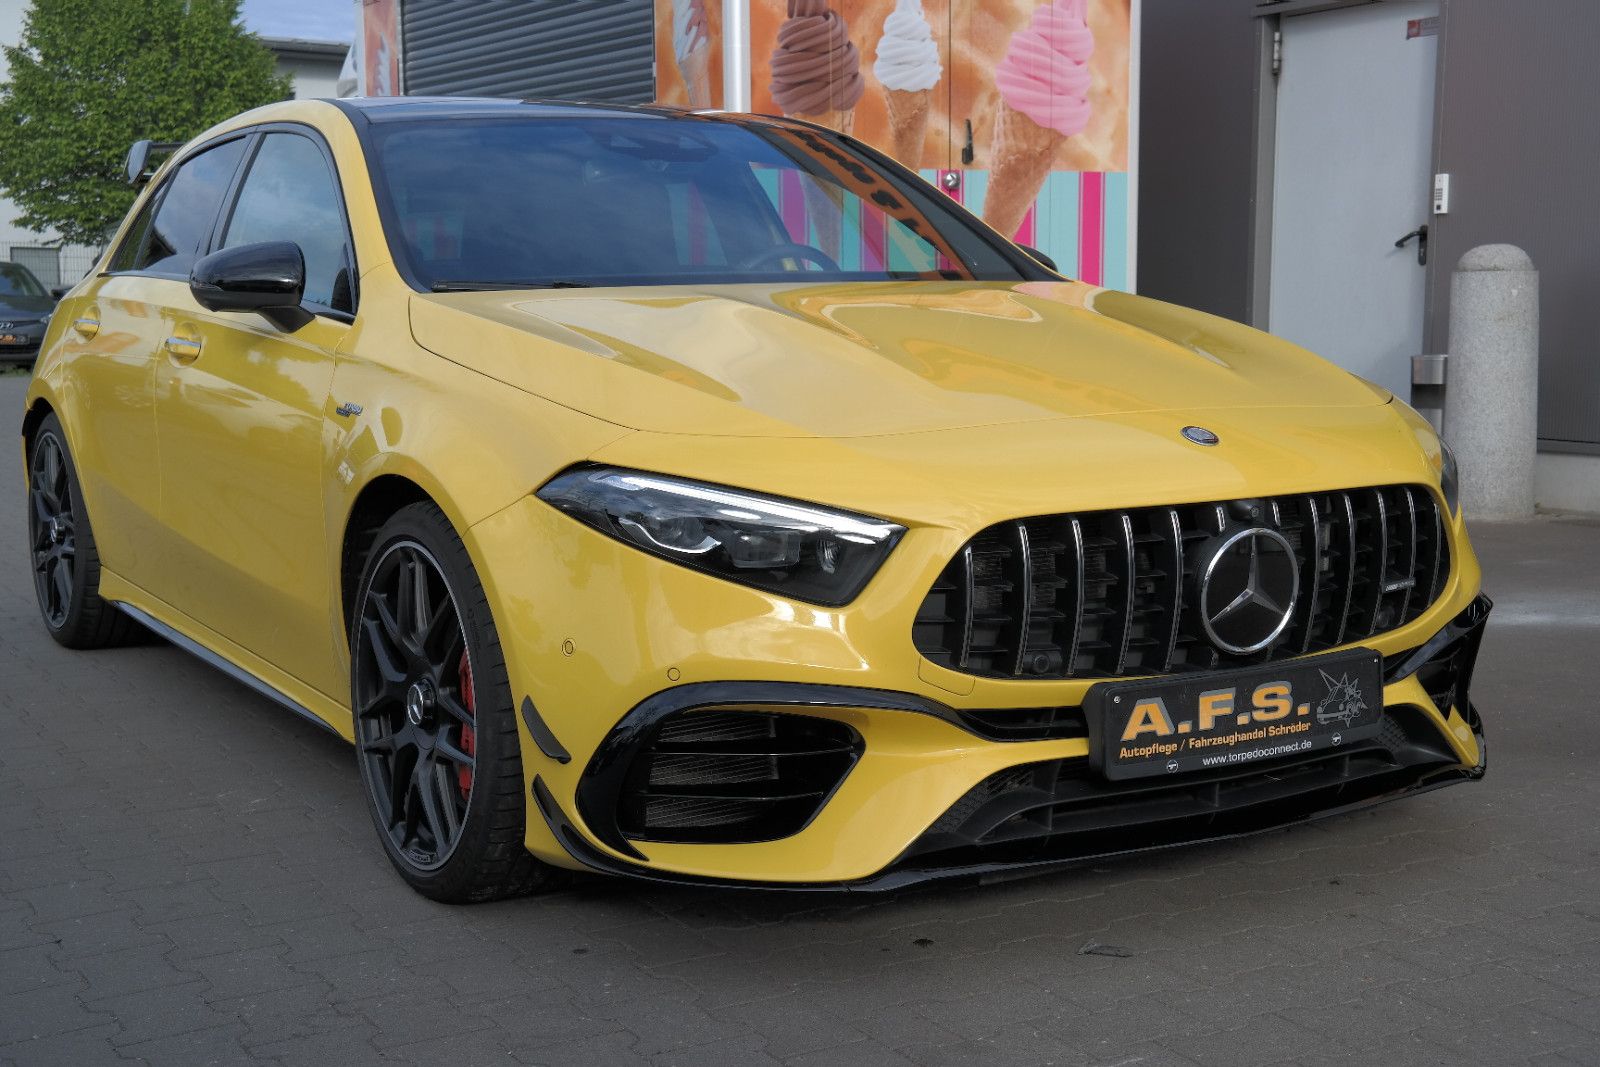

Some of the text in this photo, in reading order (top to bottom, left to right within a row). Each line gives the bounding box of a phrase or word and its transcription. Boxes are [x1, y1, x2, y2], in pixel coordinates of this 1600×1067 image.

[1120, 681, 1311, 741] A.F.S.
[1120, 721, 1311, 759] Autopflege / Fahrzeughandel Schröder
[1202, 739, 1312, 766] www.torpedoconnect.de
